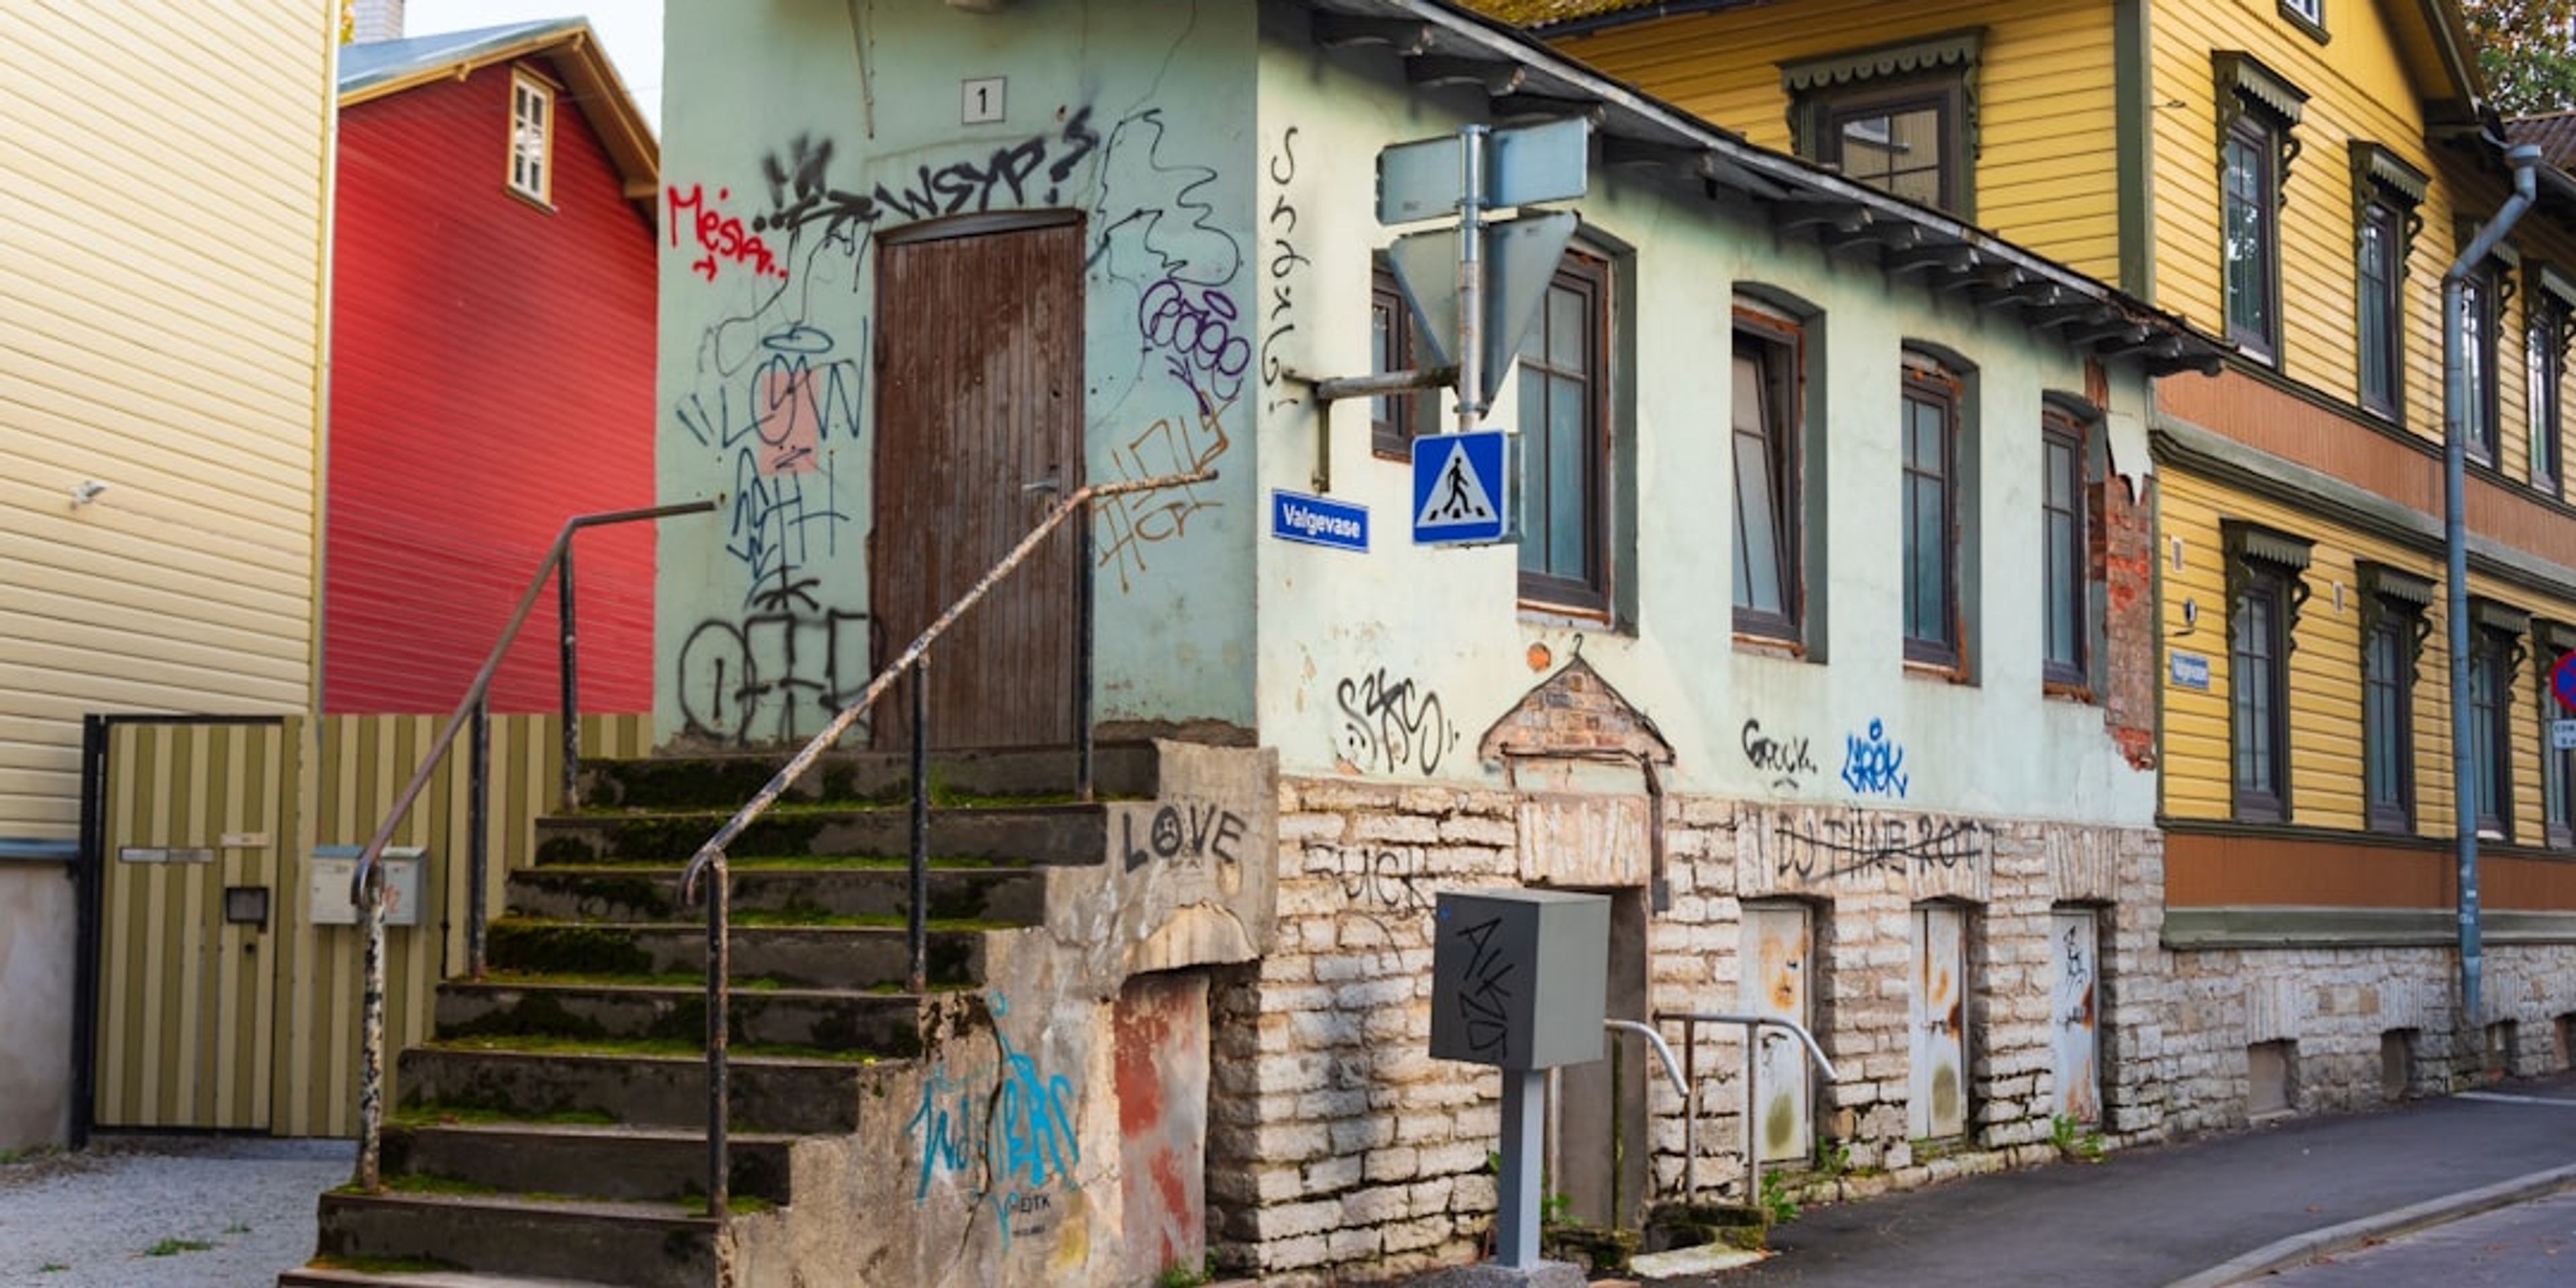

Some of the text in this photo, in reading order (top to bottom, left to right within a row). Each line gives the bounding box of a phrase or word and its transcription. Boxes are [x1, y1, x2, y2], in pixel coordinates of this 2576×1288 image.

[977, 87, 986, 114] 1
[1282, 502, 1361, 539] Valgevase
[1122, 803, 1248, 875] LOVE
